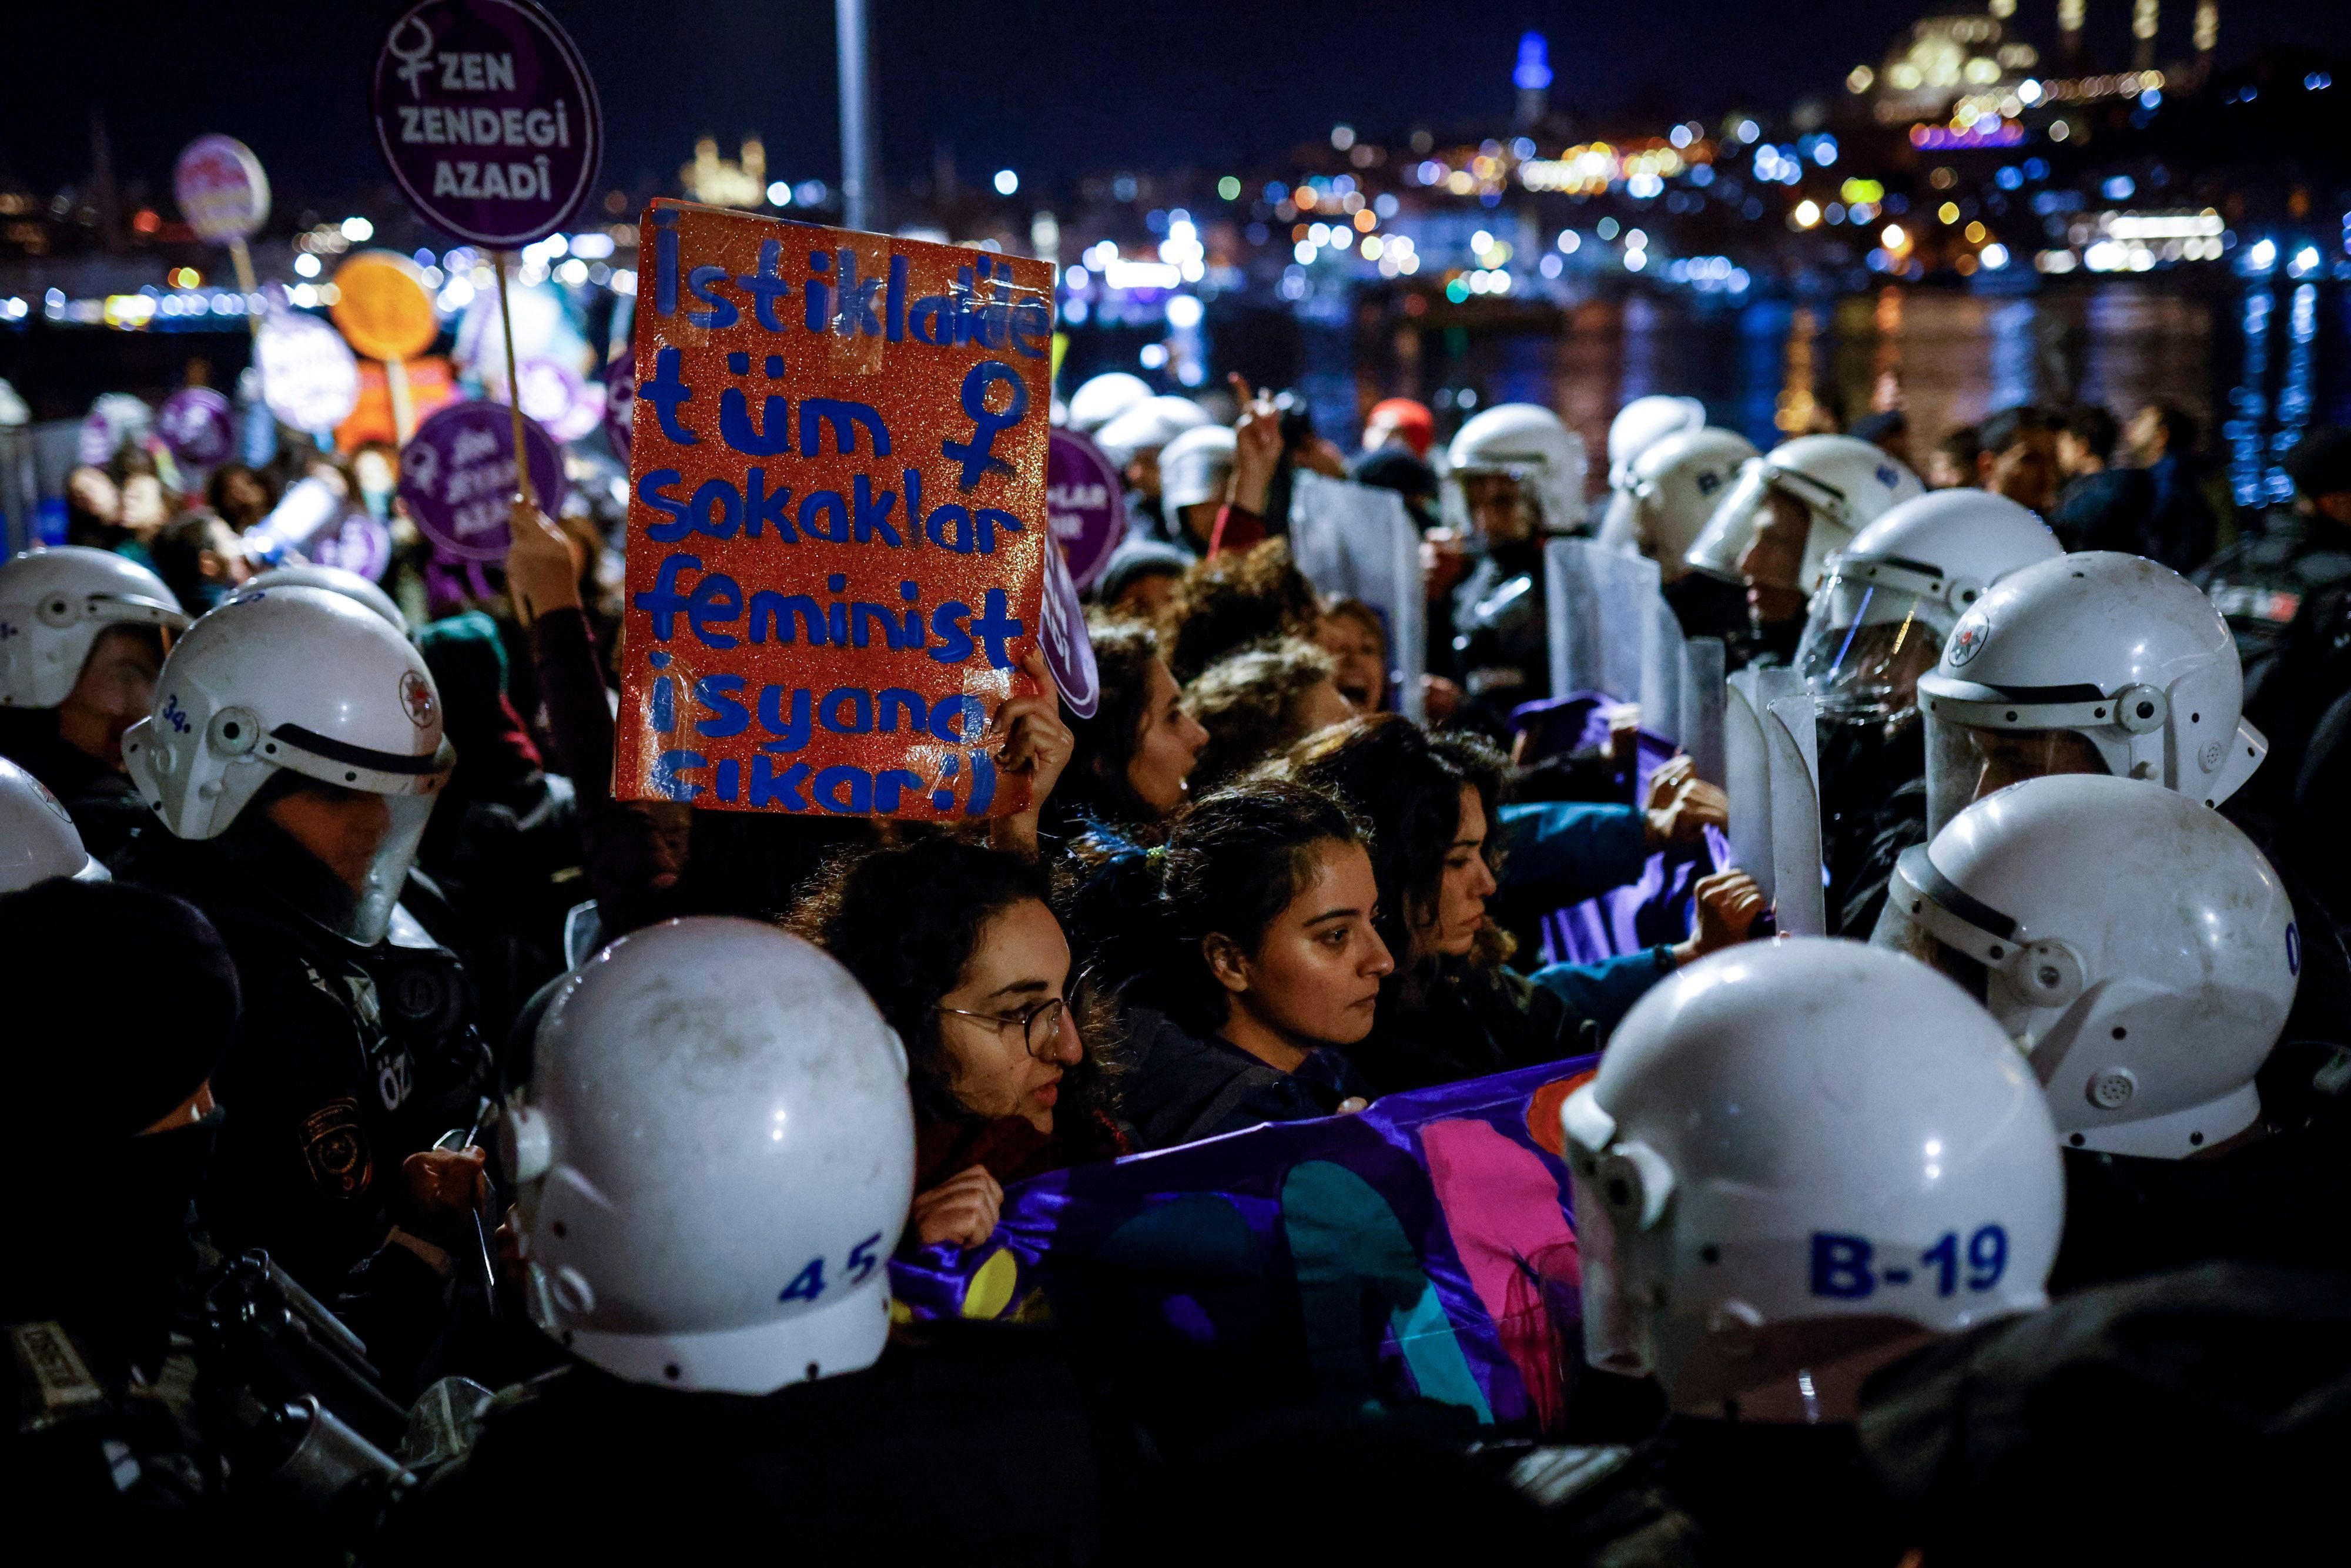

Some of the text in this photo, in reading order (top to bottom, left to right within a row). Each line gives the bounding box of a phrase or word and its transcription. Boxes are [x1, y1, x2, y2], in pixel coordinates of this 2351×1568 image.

[438, 52, 516, 92] ZEN
[397, 99, 571, 148] ZENDEGİ
[638, 345, 892, 458] tüm
[638, 467, 1023, 554] sokaklar
[634, 554, 1023, 671] feminist
[649, 651, 986, 753] isyana
[778, 1230, 883, 1303] 45
[1810, 1221, 2009, 1298] B-19
